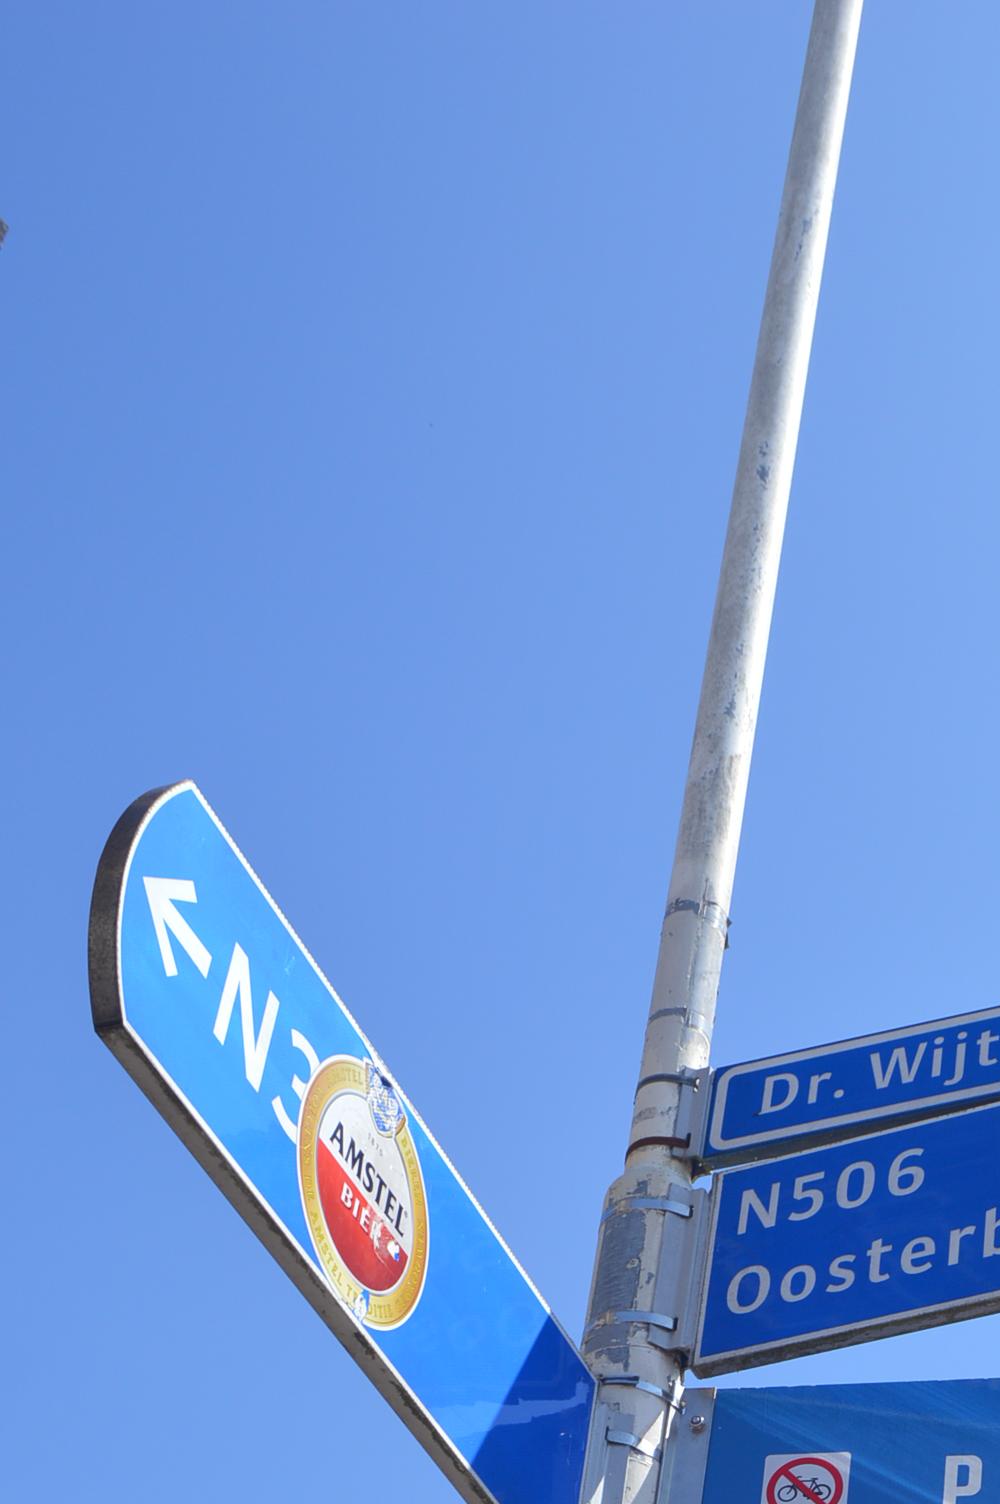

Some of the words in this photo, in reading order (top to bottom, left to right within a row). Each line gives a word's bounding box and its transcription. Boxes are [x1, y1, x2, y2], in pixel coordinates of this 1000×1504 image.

[757, 1068, 844, 1116] Dr.
[329, 1120, 405, 1237] AMSTEL
[341, 1180, 382, 1250] BIER
[735, 1146, 927, 1236] N506
